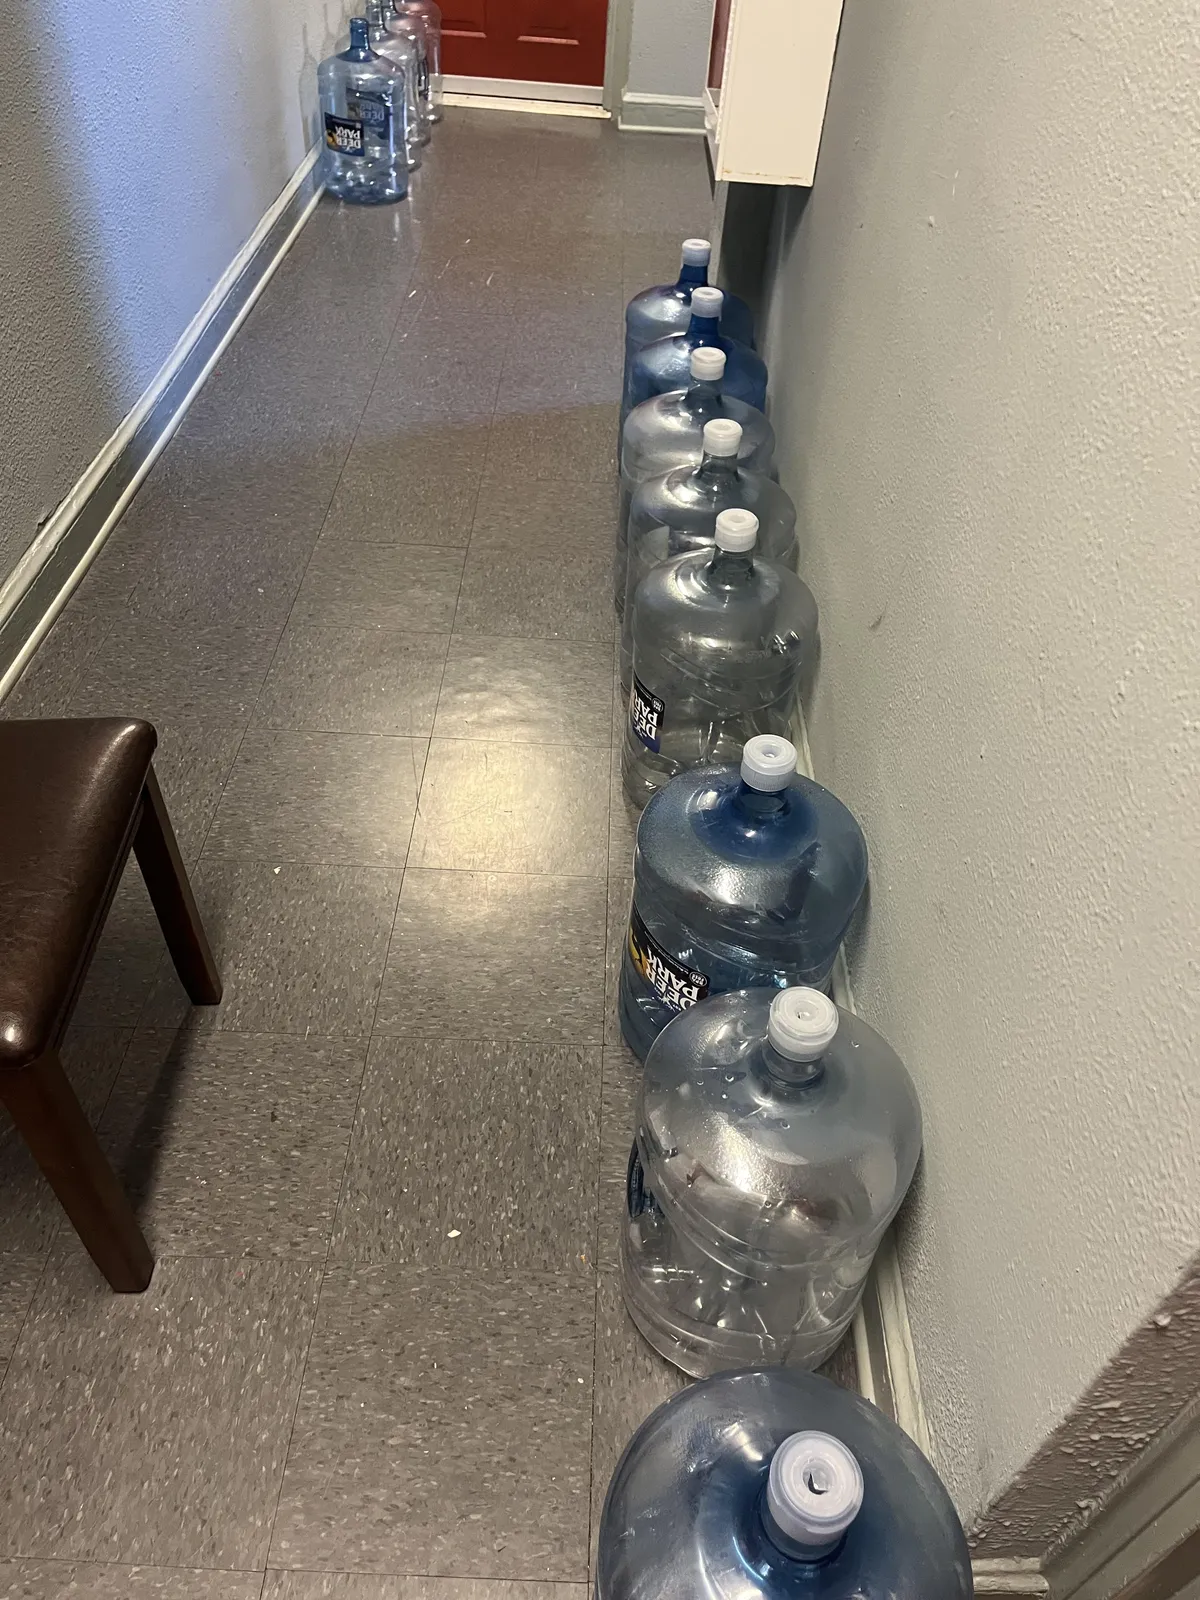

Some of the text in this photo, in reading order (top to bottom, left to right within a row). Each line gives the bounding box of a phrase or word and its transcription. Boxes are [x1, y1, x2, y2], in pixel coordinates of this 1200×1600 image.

[335, 126, 360, 140] PARK
[336, 138, 361, 149] DEER
[633, 708, 657, 740] DEE
[635, 690, 658, 726] PAR
[646, 961, 697, 1010] DEER
[647, 945, 700, 1001] PARK
